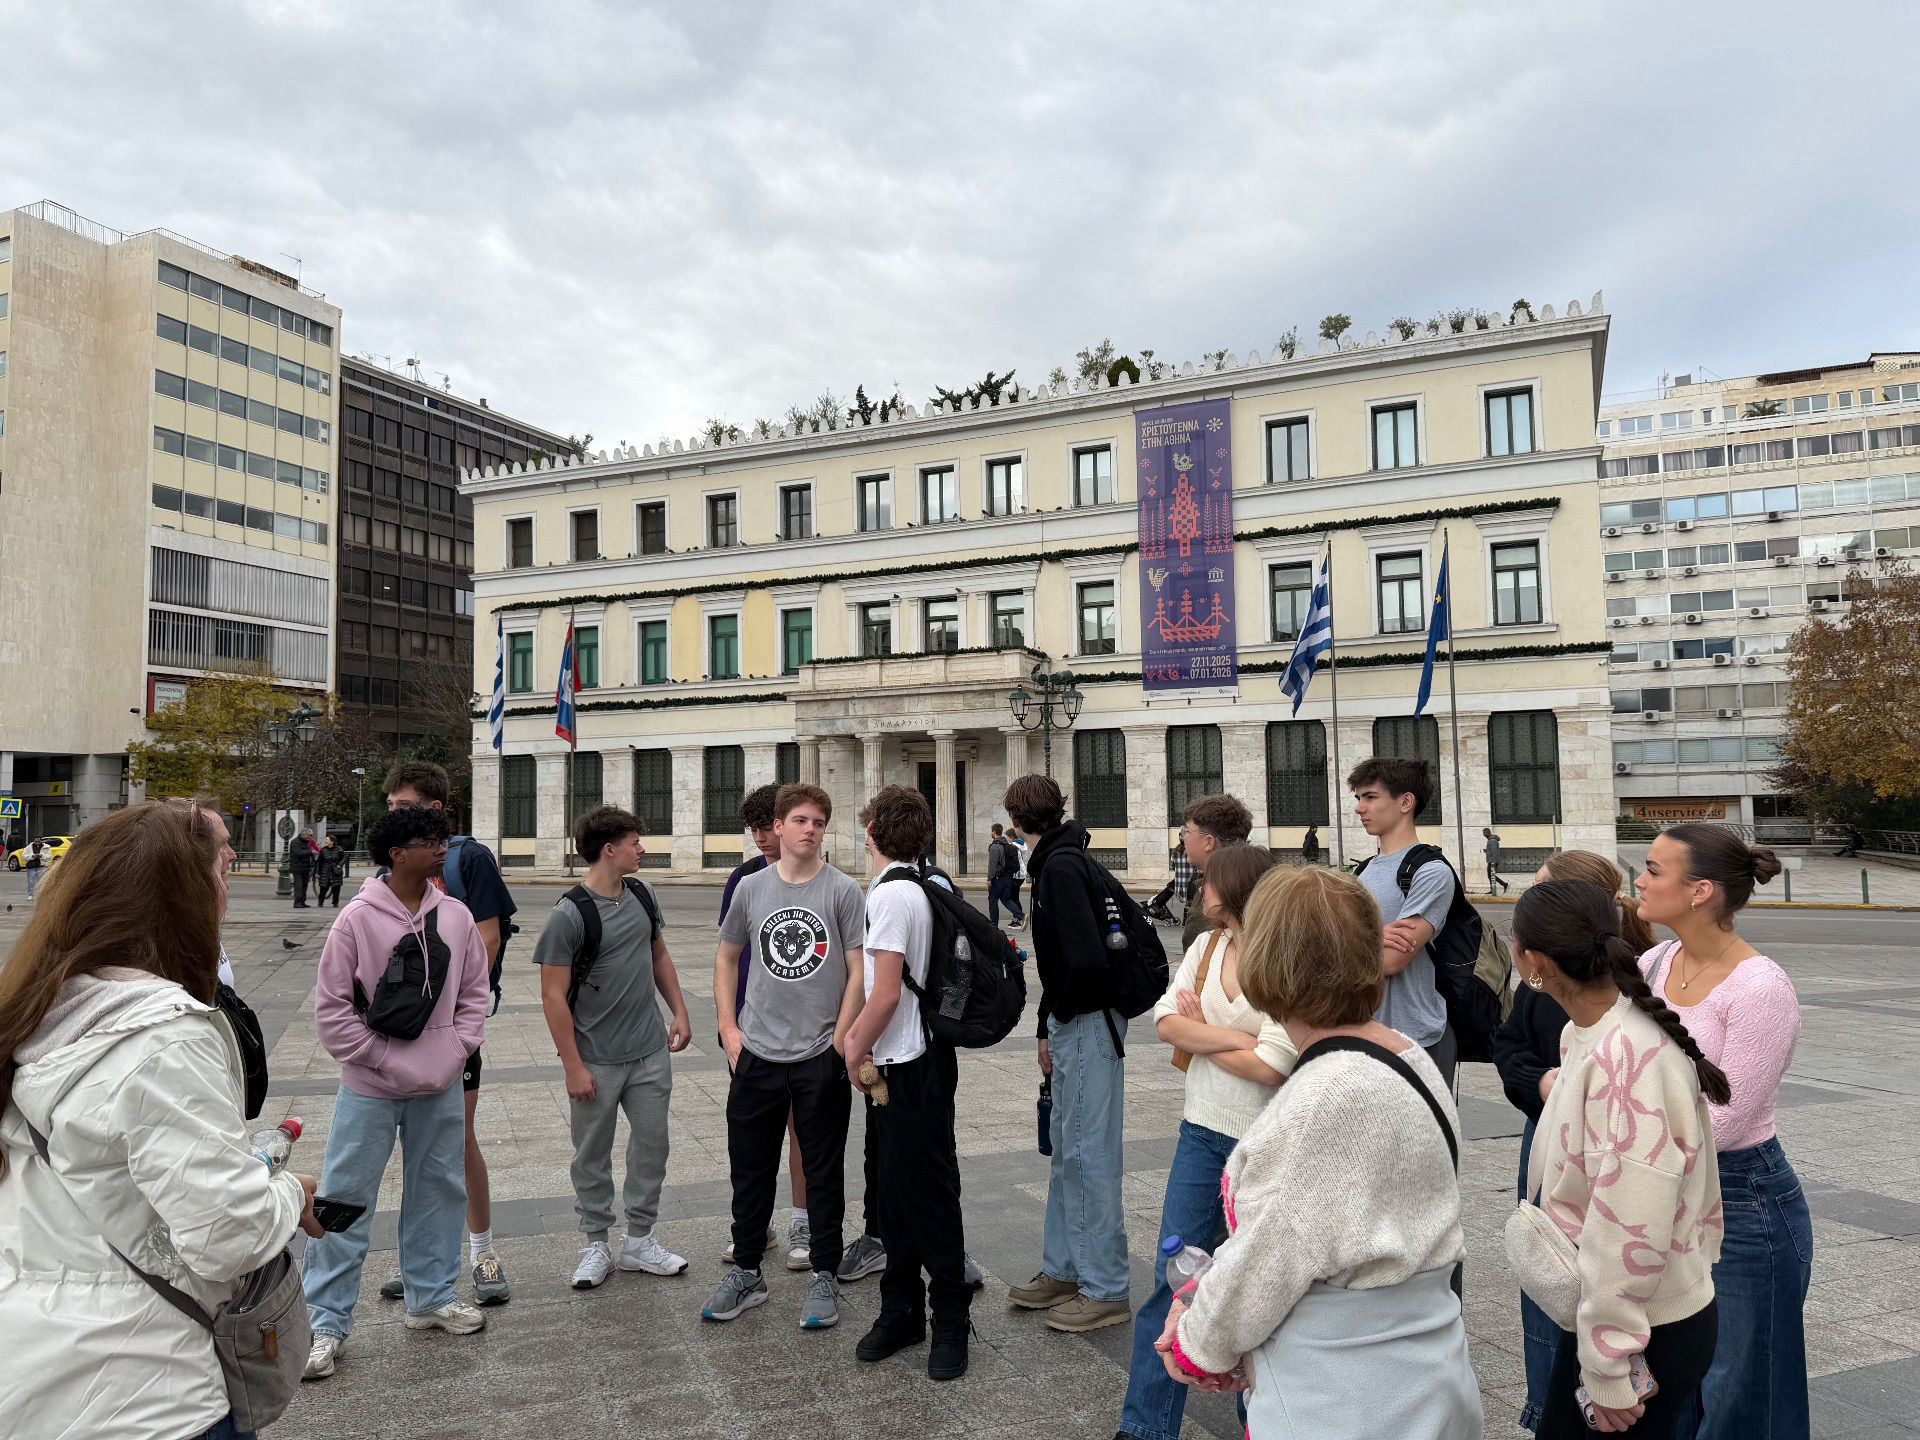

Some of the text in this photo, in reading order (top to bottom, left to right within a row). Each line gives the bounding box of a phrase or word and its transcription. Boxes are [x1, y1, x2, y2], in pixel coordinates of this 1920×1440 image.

[1141, 419, 1200, 438] ΧΡΙΣΤΟΥΓΕΝΝΑ
[1141, 432, 1191, 449] ΣΤΗΝ ΑΘΗΝΑ
[1191, 655, 1231, 668] 27.11.2025
[1190, 667, 1232, 679] 07.01.2026
[763, 910, 823, 934] SOLECKI JIU JITSU
[770, 960, 815, 977] ACADEMY
